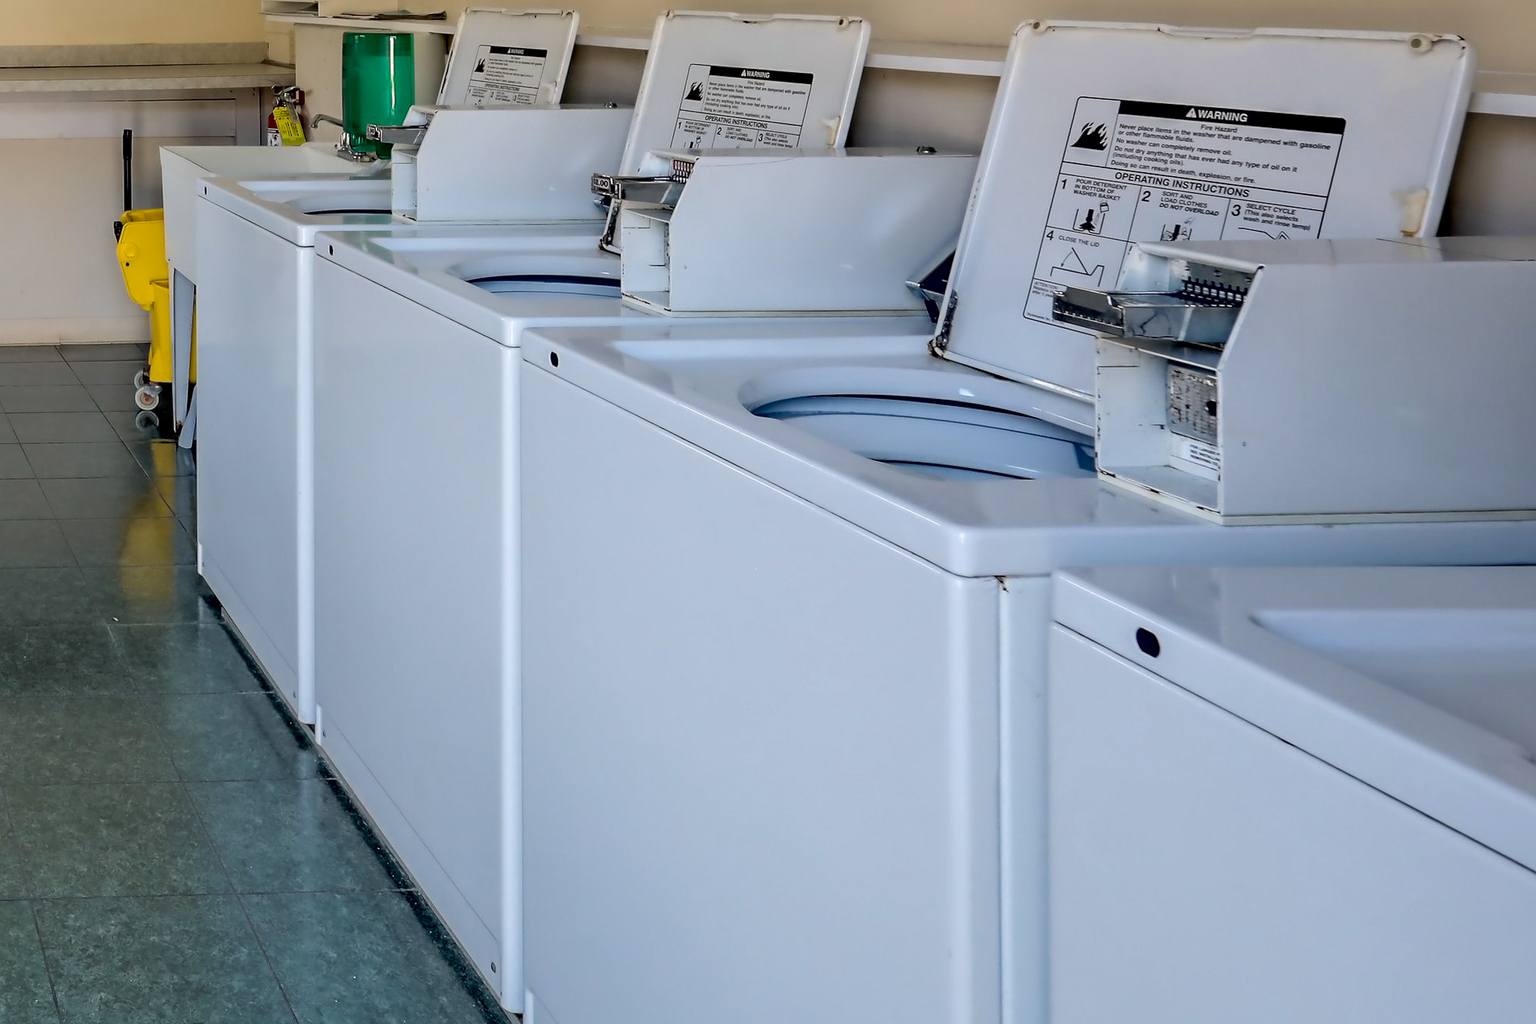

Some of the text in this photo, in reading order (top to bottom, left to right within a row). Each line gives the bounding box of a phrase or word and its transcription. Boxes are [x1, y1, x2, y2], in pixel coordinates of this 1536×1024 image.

[1197, 109, 1249, 122] WARNING
[704, 114, 768, 130] OPERATING INSTRUCTIONS
[716, 127, 723, 136] 2
[758, 132, 764, 142] 3
[1137, 126, 1154, 134] place
[1244, 136, 1281, 145] dampened
[1142, 132, 1174, 140] flammable
[1160, 143, 1195, 152] completely
[1135, 148, 1145, 157] dry
[1146, 150, 1173, 159] anything
[1174, 153, 1187, 161] that
[1143, 155, 1168, 164] cooking
[1110, 159, 1128, 168] Doing
[1061, 178, 1067, 189] 1
[1075, 178, 1127, 190] POUR DETERGENT
[1114, 172, 1249, 197] OPERATING INSTRUCTIONS
[1141, 190, 1151, 202] 2
[1178, 199, 1207, 208] CLOTHES
[1246, 203, 1296, 215] SELECT CYCLE
[1184, 206, 1219, 216] OVERLOAD
[1231, 204, 1241, 216] 3
[1260, 212, 1274, 221] also
[1046, 230, 1054, 241] 4
[1058, 235, 1076, 243] CLOSE
